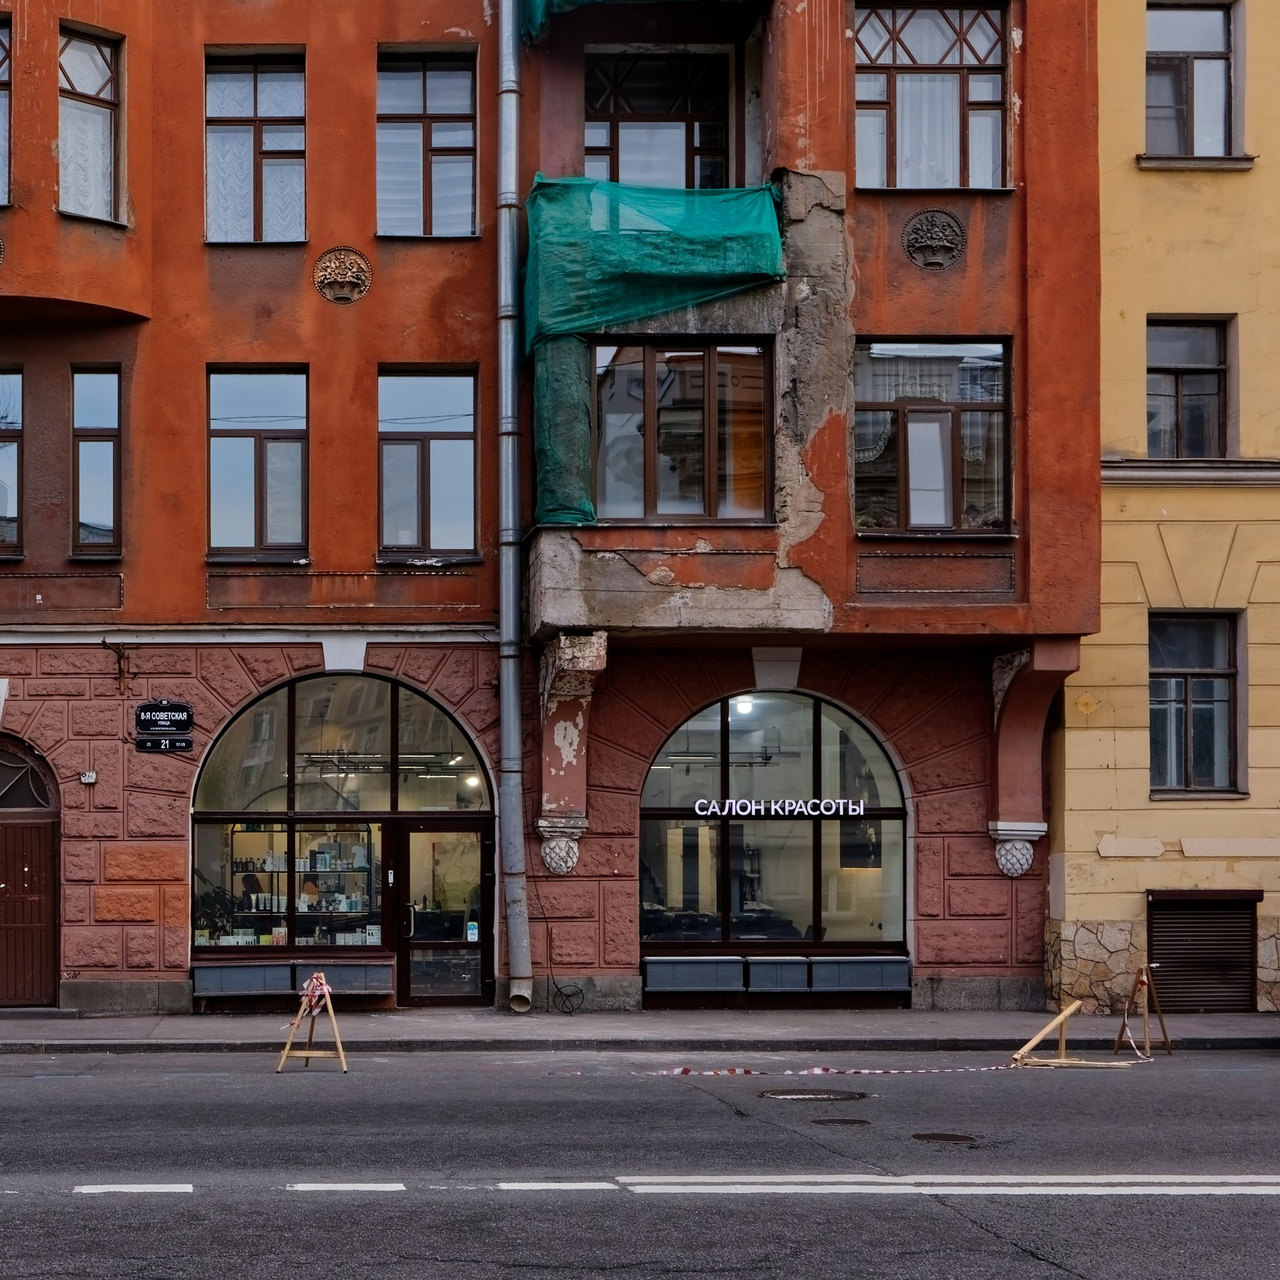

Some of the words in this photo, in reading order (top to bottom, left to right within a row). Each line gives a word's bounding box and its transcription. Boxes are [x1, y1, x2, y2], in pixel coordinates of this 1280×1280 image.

[140, 712, 151, 720] 8-Я
[151, 712, 187, 720] СОВЕТСКАЯ
[160, 740, 169, 749] 21
[694, 799, 765, 816] САЛОН
[770, 799, 864, 816] КРАСОТЫ
